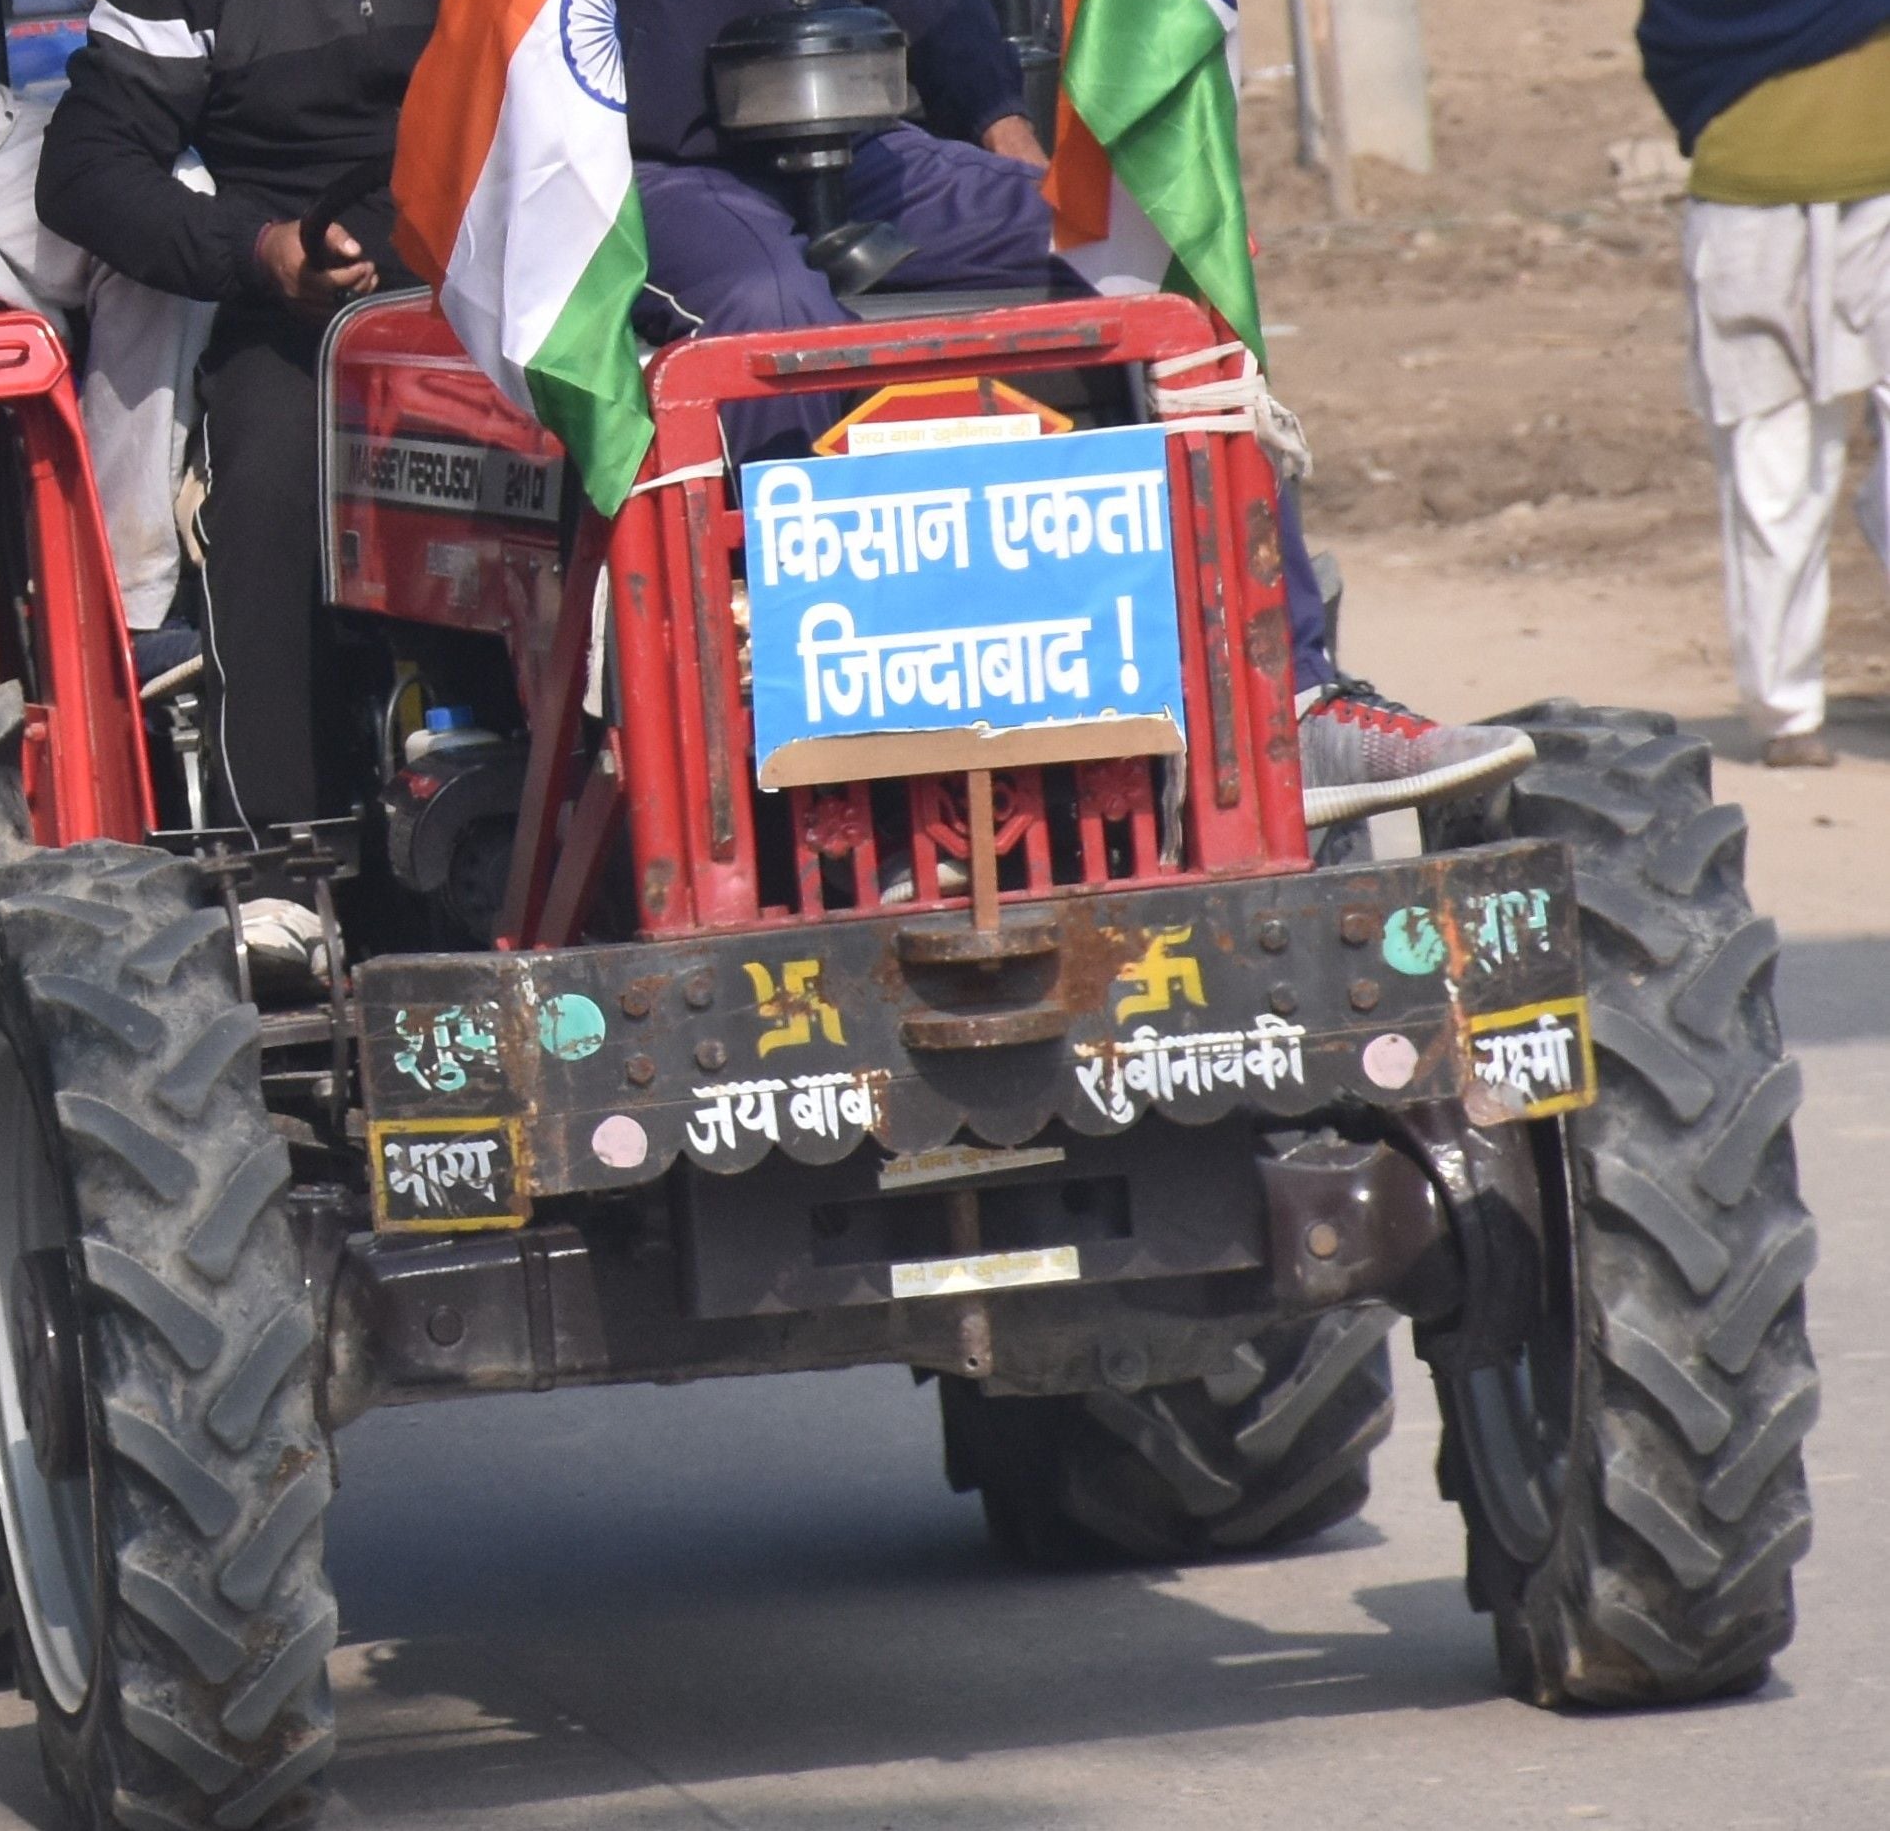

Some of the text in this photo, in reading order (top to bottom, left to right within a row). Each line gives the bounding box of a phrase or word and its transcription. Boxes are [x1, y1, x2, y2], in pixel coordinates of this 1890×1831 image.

[349, 442, 403, 492] MASSEY
[408, 449, 483, 503] FERGUSON
[754, 465, 1165, 587] किसान एकता
[796, 595, 1140, 723] जिन्दाबाद !
[1474, 1014, 1574, 1104] लक्ष्मी
[686, 1079, 789, 1154] जय
[385, 1139, 498, 1207] भाग्य
